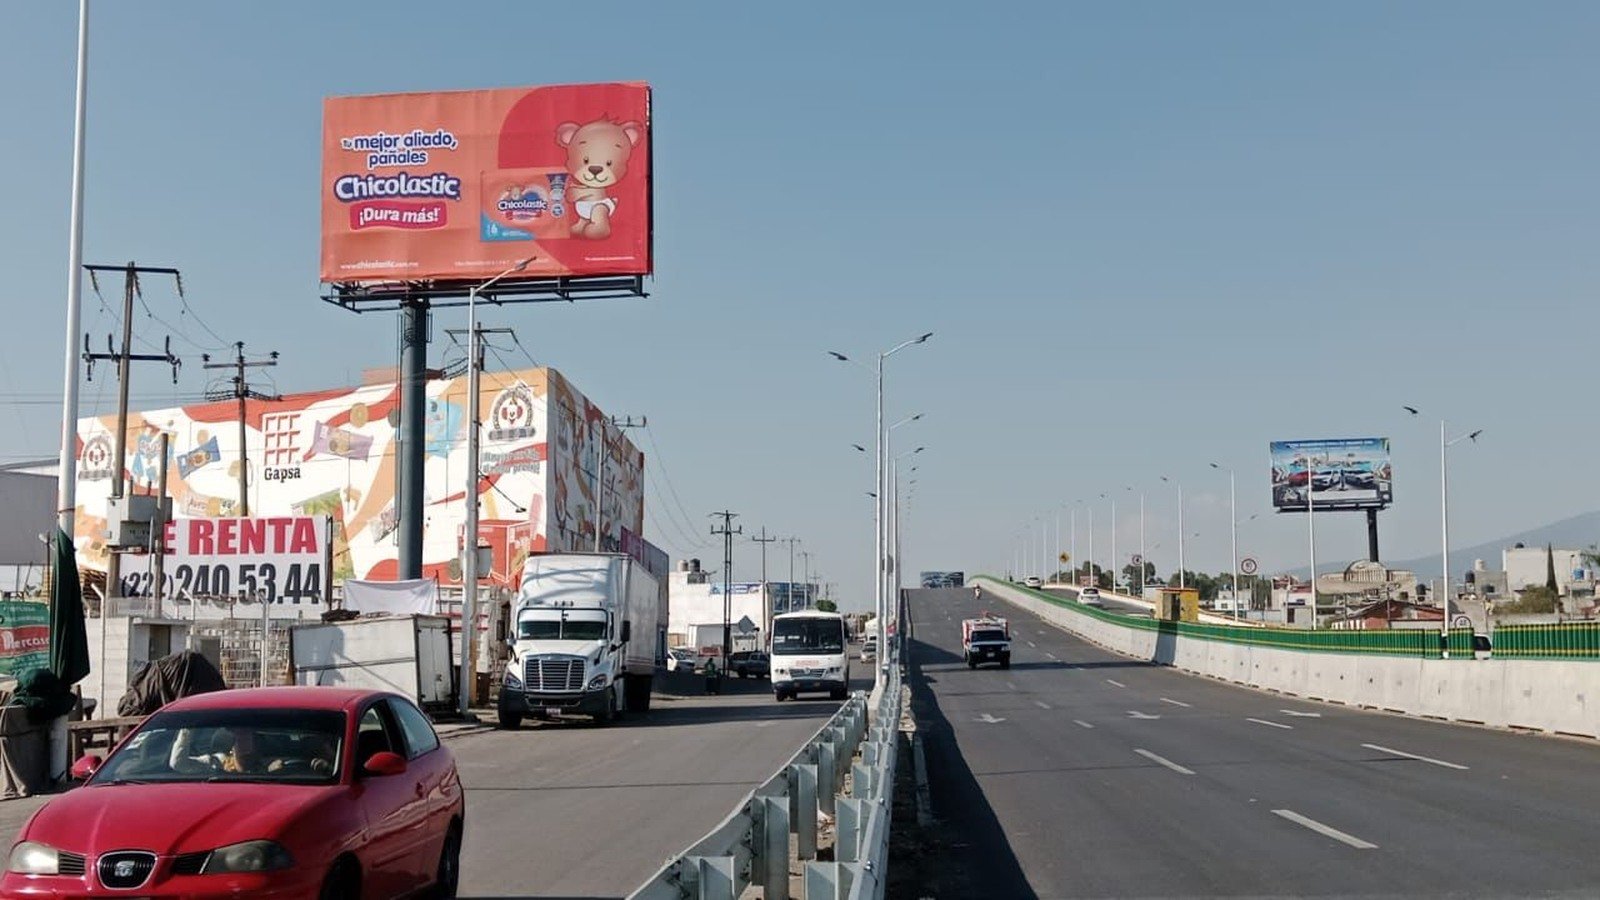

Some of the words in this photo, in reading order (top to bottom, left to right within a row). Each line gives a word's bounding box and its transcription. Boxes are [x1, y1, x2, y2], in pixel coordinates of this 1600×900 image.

[354, 133, 401, 152] mejor
[403, 130, 457, 148] aliado,
[368, 149, 427, 168] pañales
[334, 172, 460, 201] Chicolastic
[497, 199, 548, 211] Chicolastic
[359, 207, 400, 226] ¡Dura
[264, 466, 301, 483] Gapsa
[188, 517, 318, 556] RENTA
[175, 562, 322, 607] 24053.44
